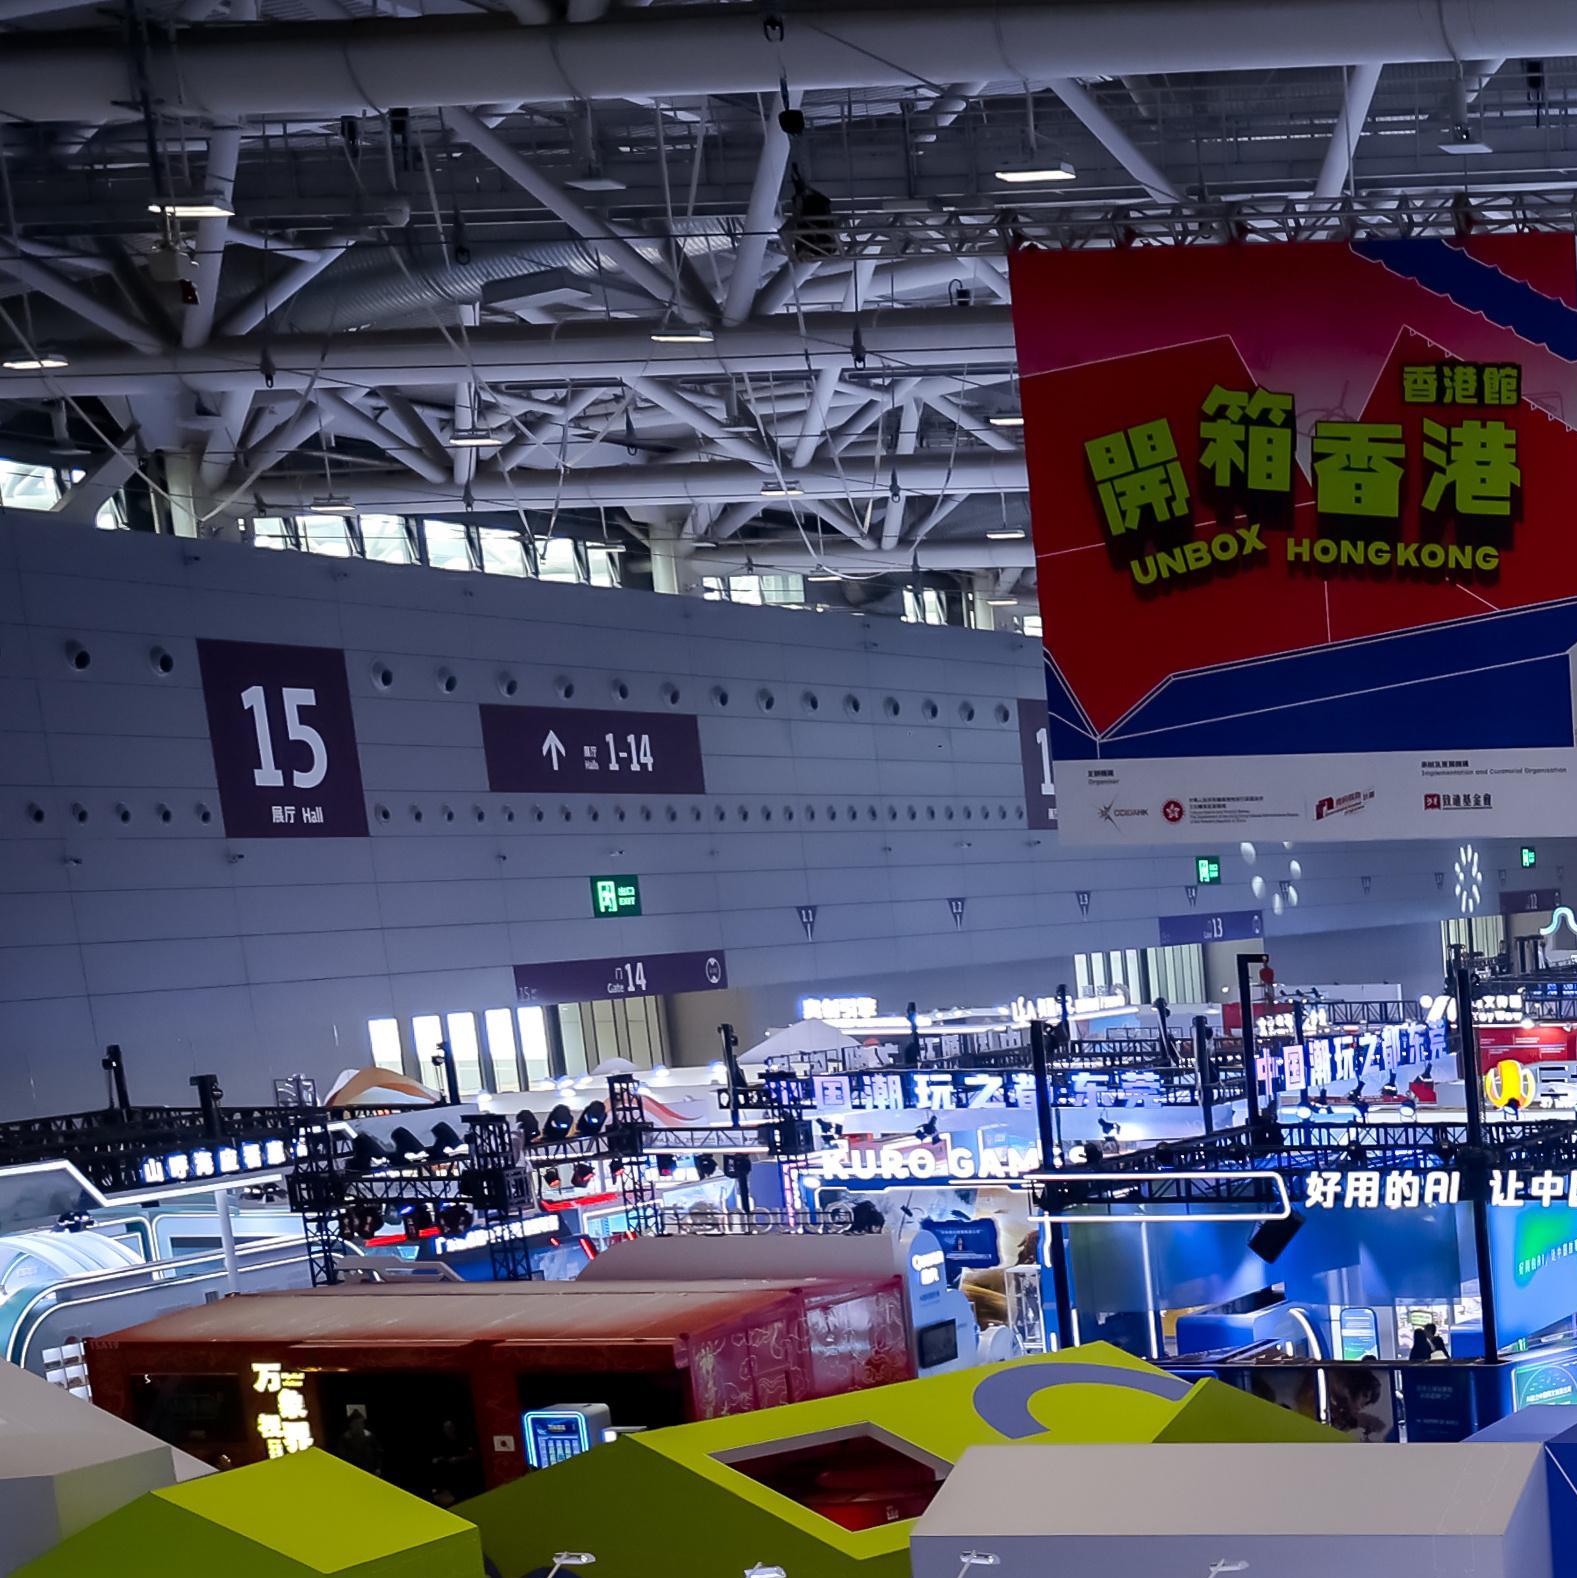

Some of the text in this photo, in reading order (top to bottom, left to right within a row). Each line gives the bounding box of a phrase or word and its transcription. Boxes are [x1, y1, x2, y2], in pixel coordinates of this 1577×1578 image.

[1403, 365, 1520, 406] 香港館
[1085, 385, 1521, 536] 開箱香港
[1131, 523, 1267, 585] UNBOX
[240, 685, 329, 789] 15
[605, 732, 654, 774] 1-14
[271, 805, 325, 824] 展厅 Hall
[1212, 917, 1224, 938] 13
[625, 961, 647, 992] 14
[822, 1147, 1088, 1179] KURO GAMS
[1306, 1171, 1460, 1209] 好用的AI
